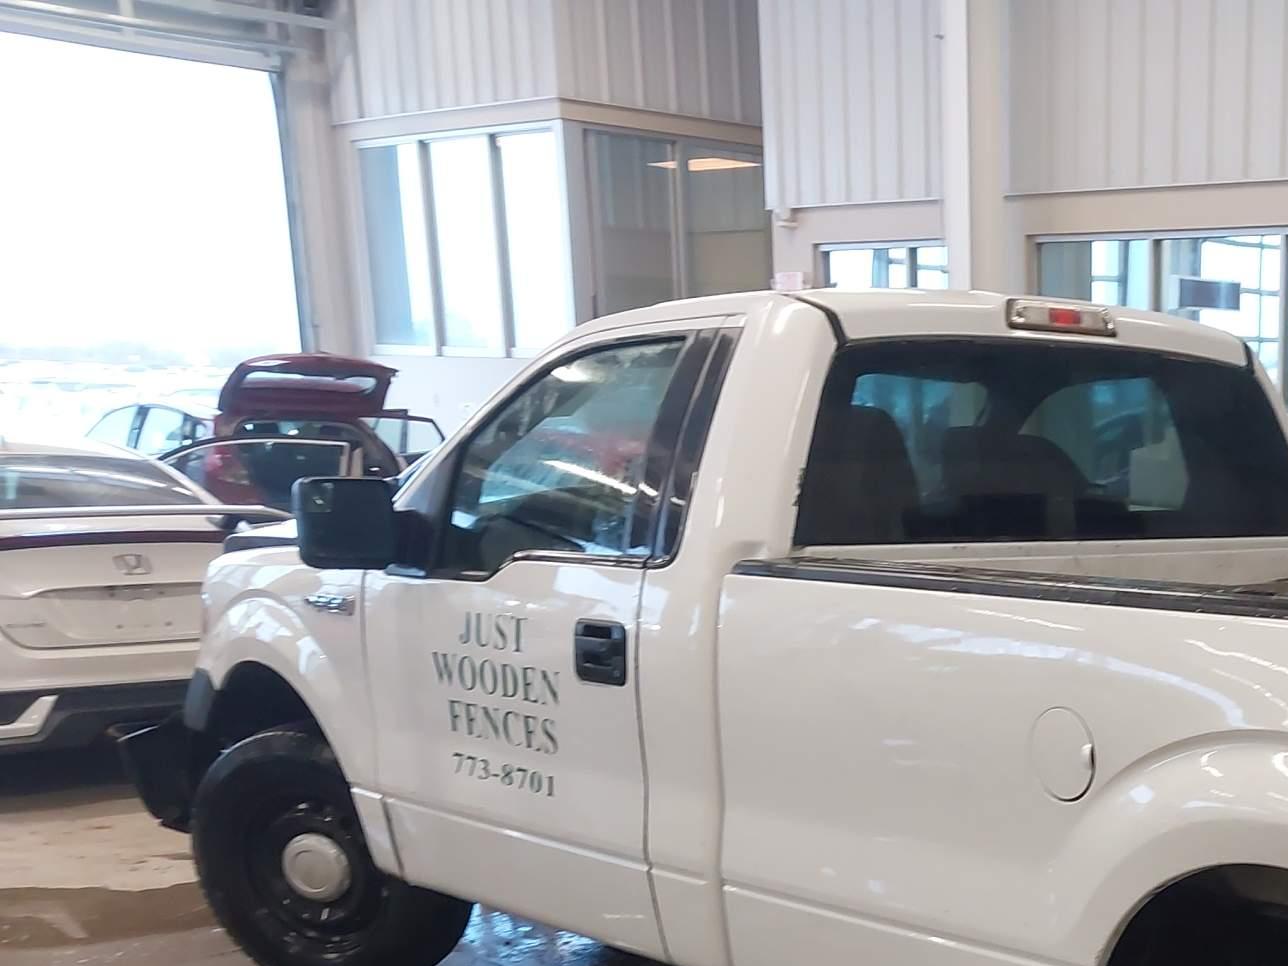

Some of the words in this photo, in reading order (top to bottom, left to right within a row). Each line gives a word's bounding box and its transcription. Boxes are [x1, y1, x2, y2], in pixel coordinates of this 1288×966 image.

[458, 611, 528, 653] JUST
[431, 651, 560, 705] WOODEN
[447, 699, 559, 755] FENCES
[452, 752, 555, 797] 773-8701
